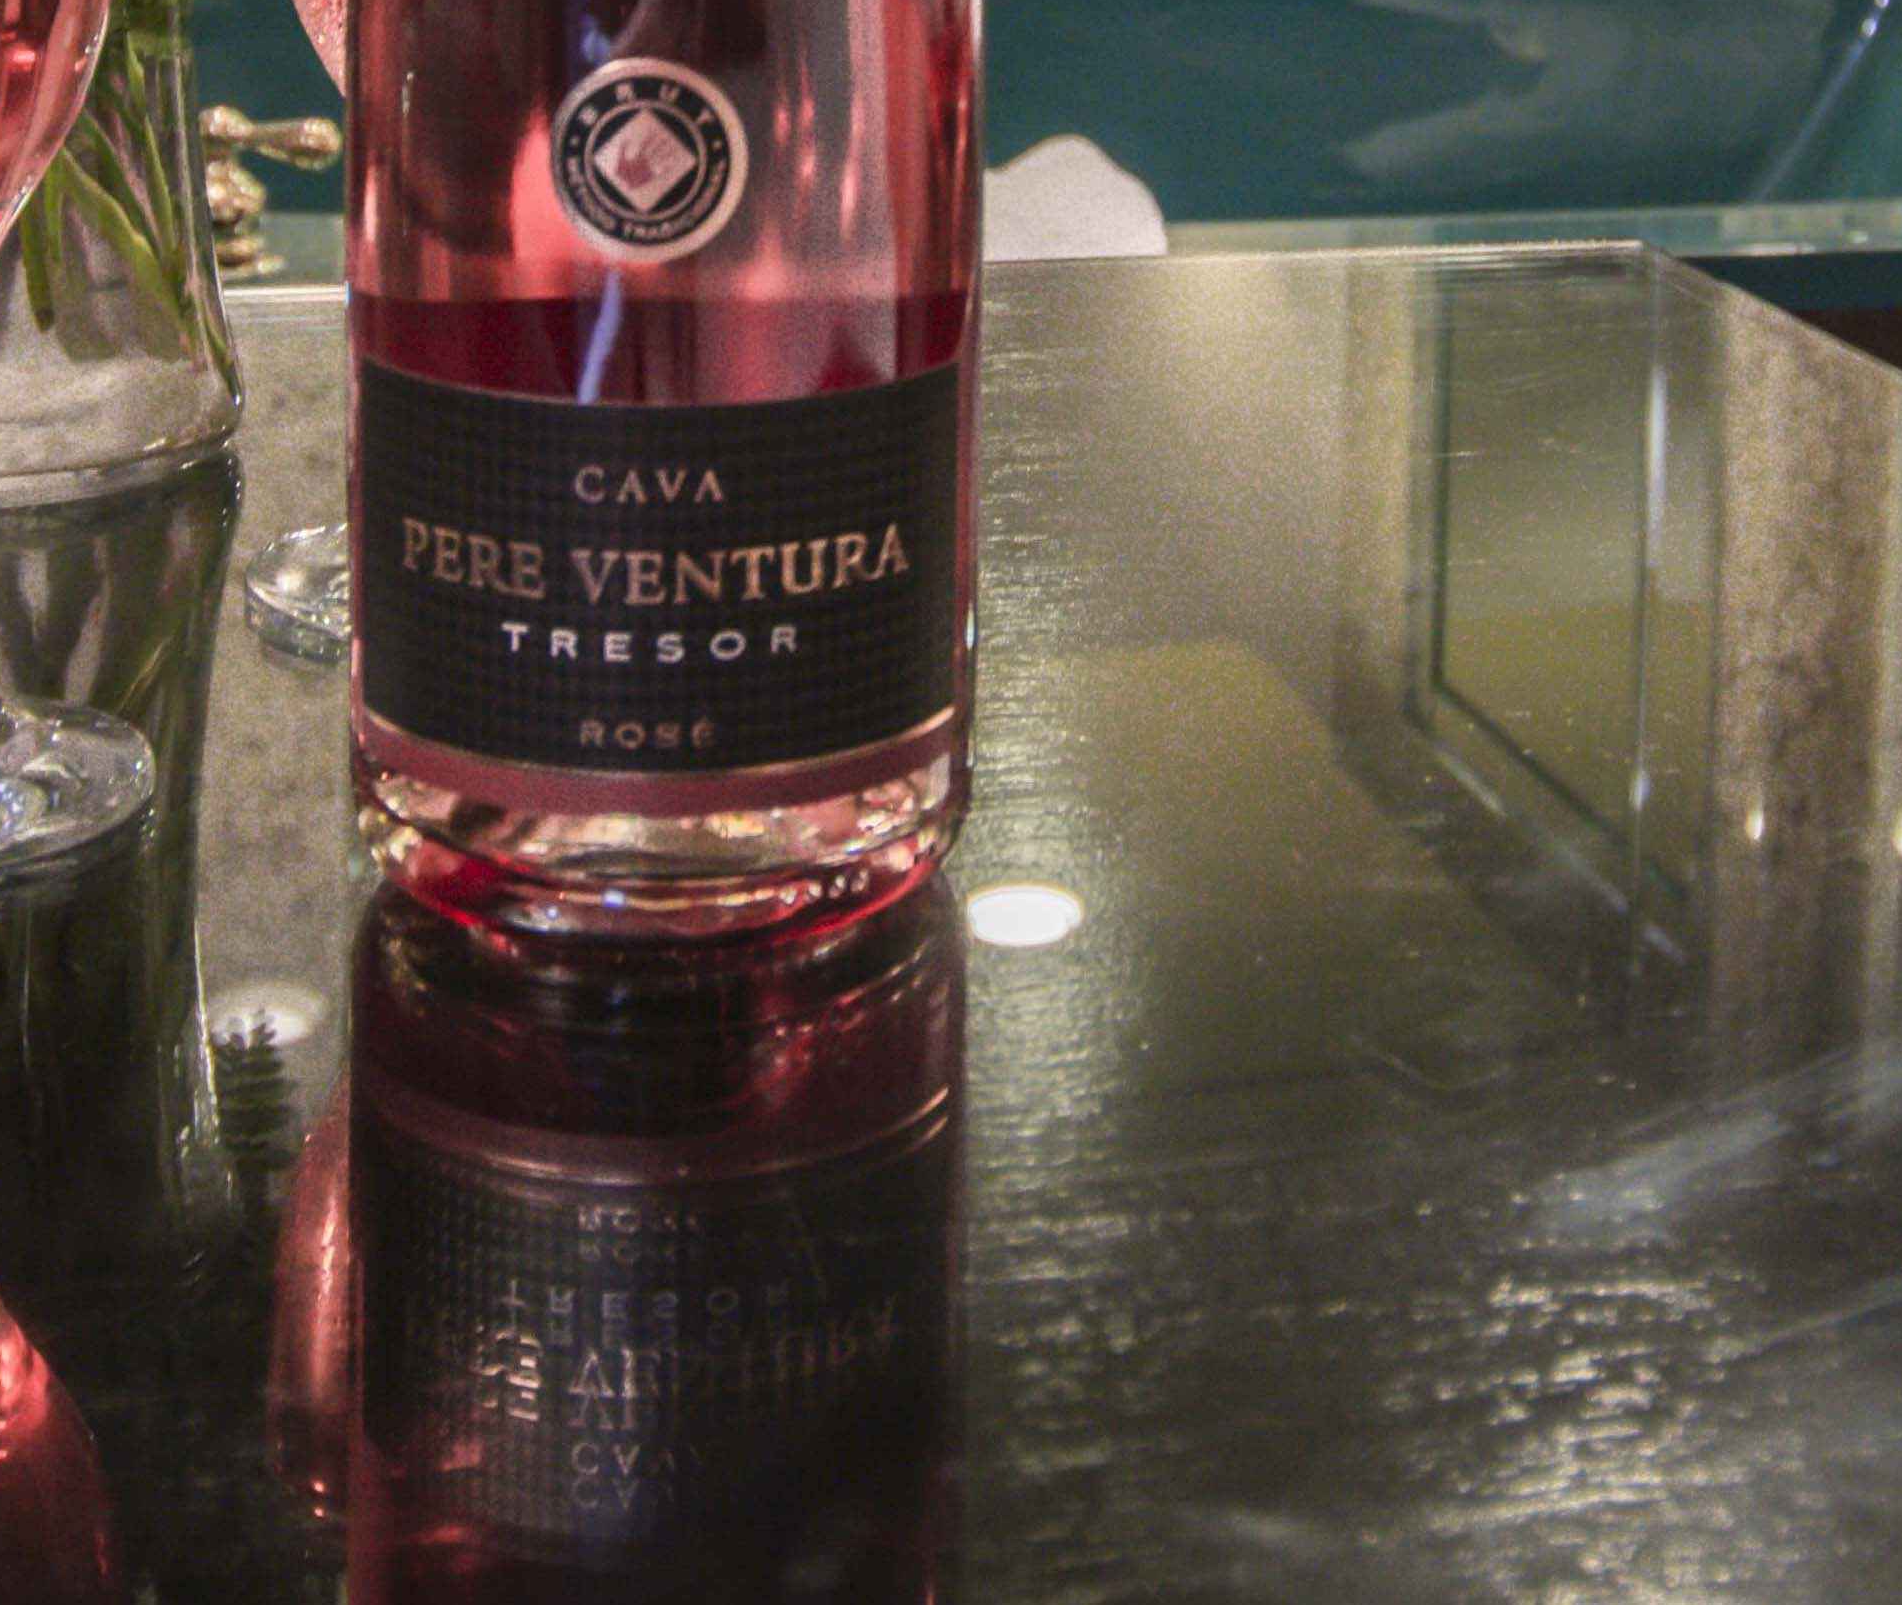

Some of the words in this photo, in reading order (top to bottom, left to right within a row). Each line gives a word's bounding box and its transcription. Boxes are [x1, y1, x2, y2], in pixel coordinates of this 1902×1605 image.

[574, 466, 725, 503] CAVA
[402, 517, 545, 598] PERE
[570, 523, 909, 606] VENTURA
[501, 621, 798, 664] TRESOR
